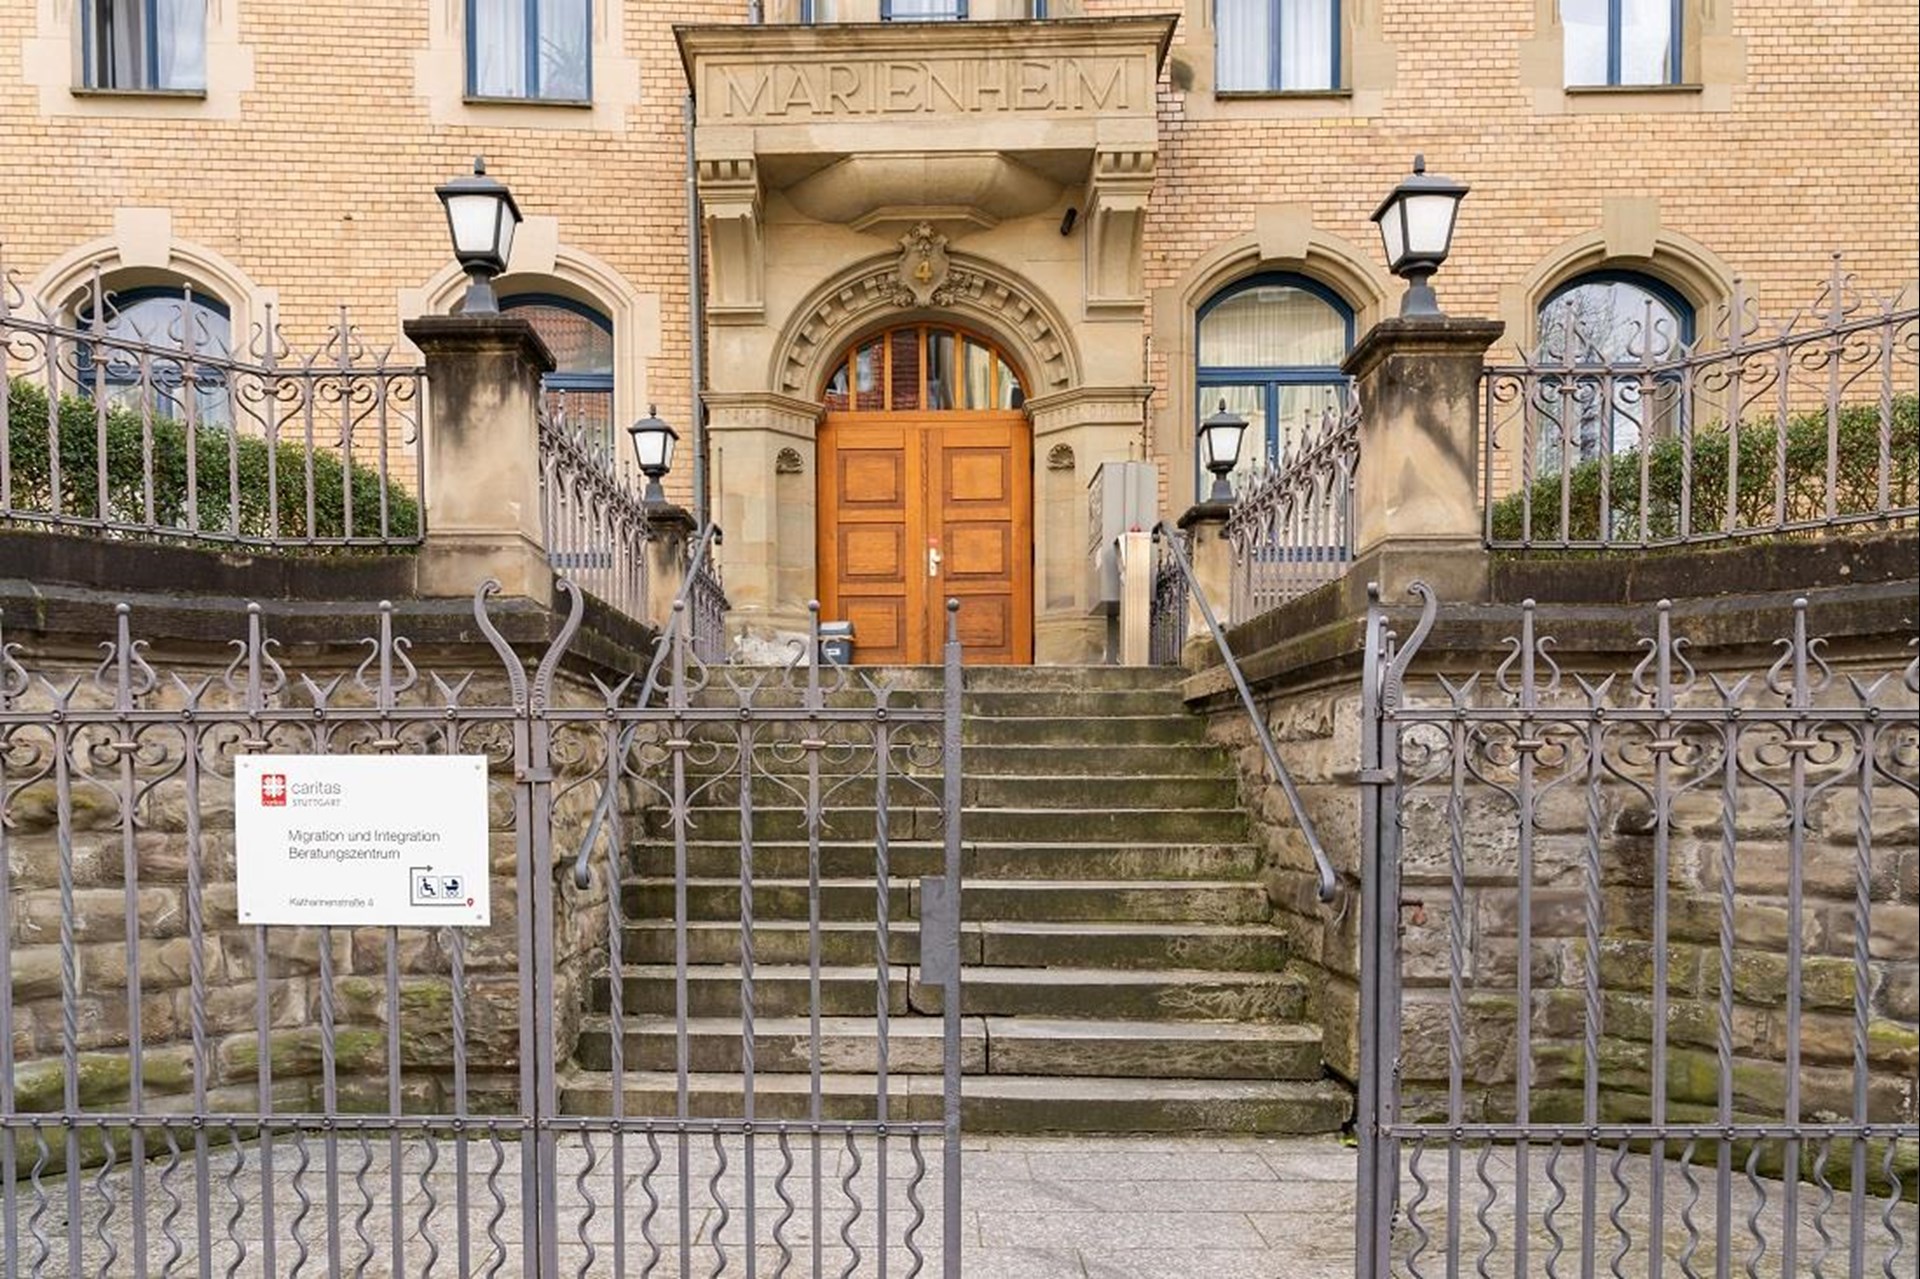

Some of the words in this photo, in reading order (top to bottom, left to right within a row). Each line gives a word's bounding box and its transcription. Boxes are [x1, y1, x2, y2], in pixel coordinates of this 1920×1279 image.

[722, 57, 1129, 117] MARIENHEIM
[915, 260, 932, 283] 4
[291, 781, 342, 795] caritas
[292, 798, 341, 807] STUTTGART
[288, 829, 345, 844] Migration
[348, 829, 371, 842] und
[374, 829, 440, 845] Integration
[288, 846, 400, 862] Beratungszentrum
